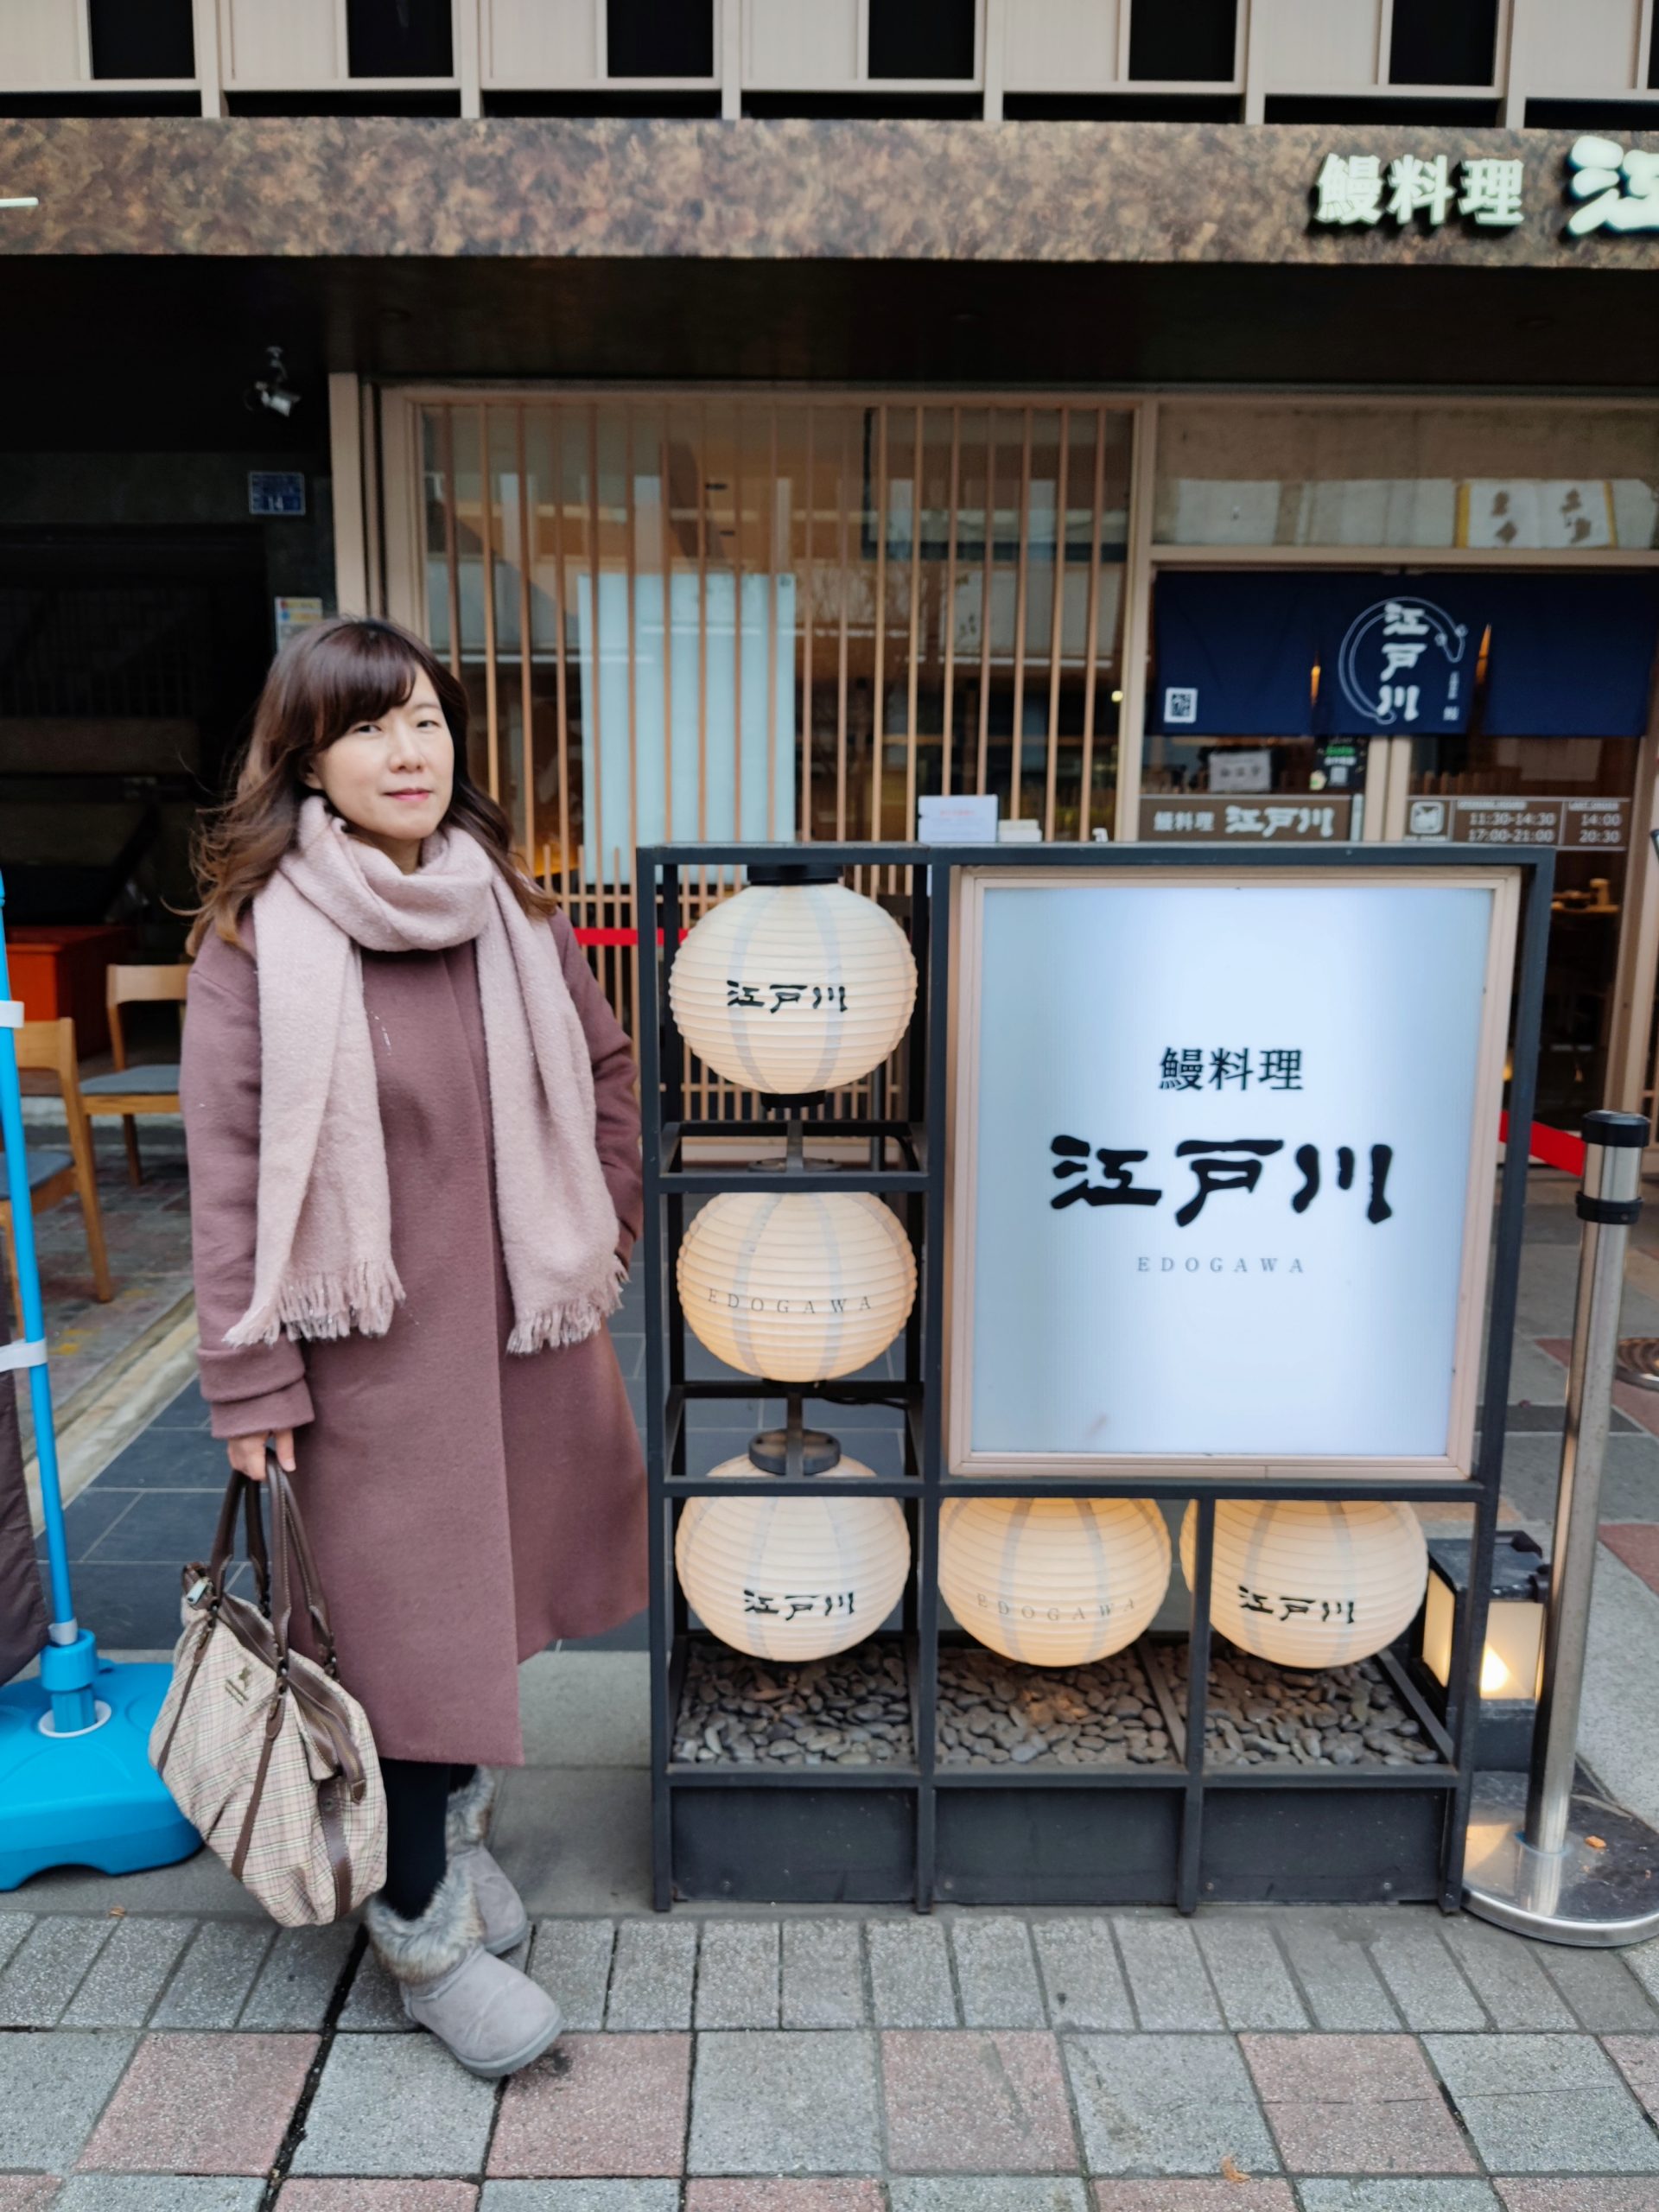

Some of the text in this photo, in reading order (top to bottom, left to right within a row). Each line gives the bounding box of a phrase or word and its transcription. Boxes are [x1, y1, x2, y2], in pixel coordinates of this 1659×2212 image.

[1314, 153, 1524, 226] 鰻料理
[1377, 602, 1429, 721] 江戸川
[1225, 805, 1334, 838] 江戸川
[727, 980, 848, 1014] 江戸川
[1159, 1046, 1304, 1090] 鰻料理
[1051, 1135, 1393, 1227] 江戸川
[1136, 1255, 1305, 1274] EDOGAWA
[708, 1287, 873, 1315] EDOGAWA
[743, 1589, 855, 1621] 江戸川
[976, 1592, 1135, 1622] EDOGAWA
[1237, 1584, 1356, 1624] 江戸川
